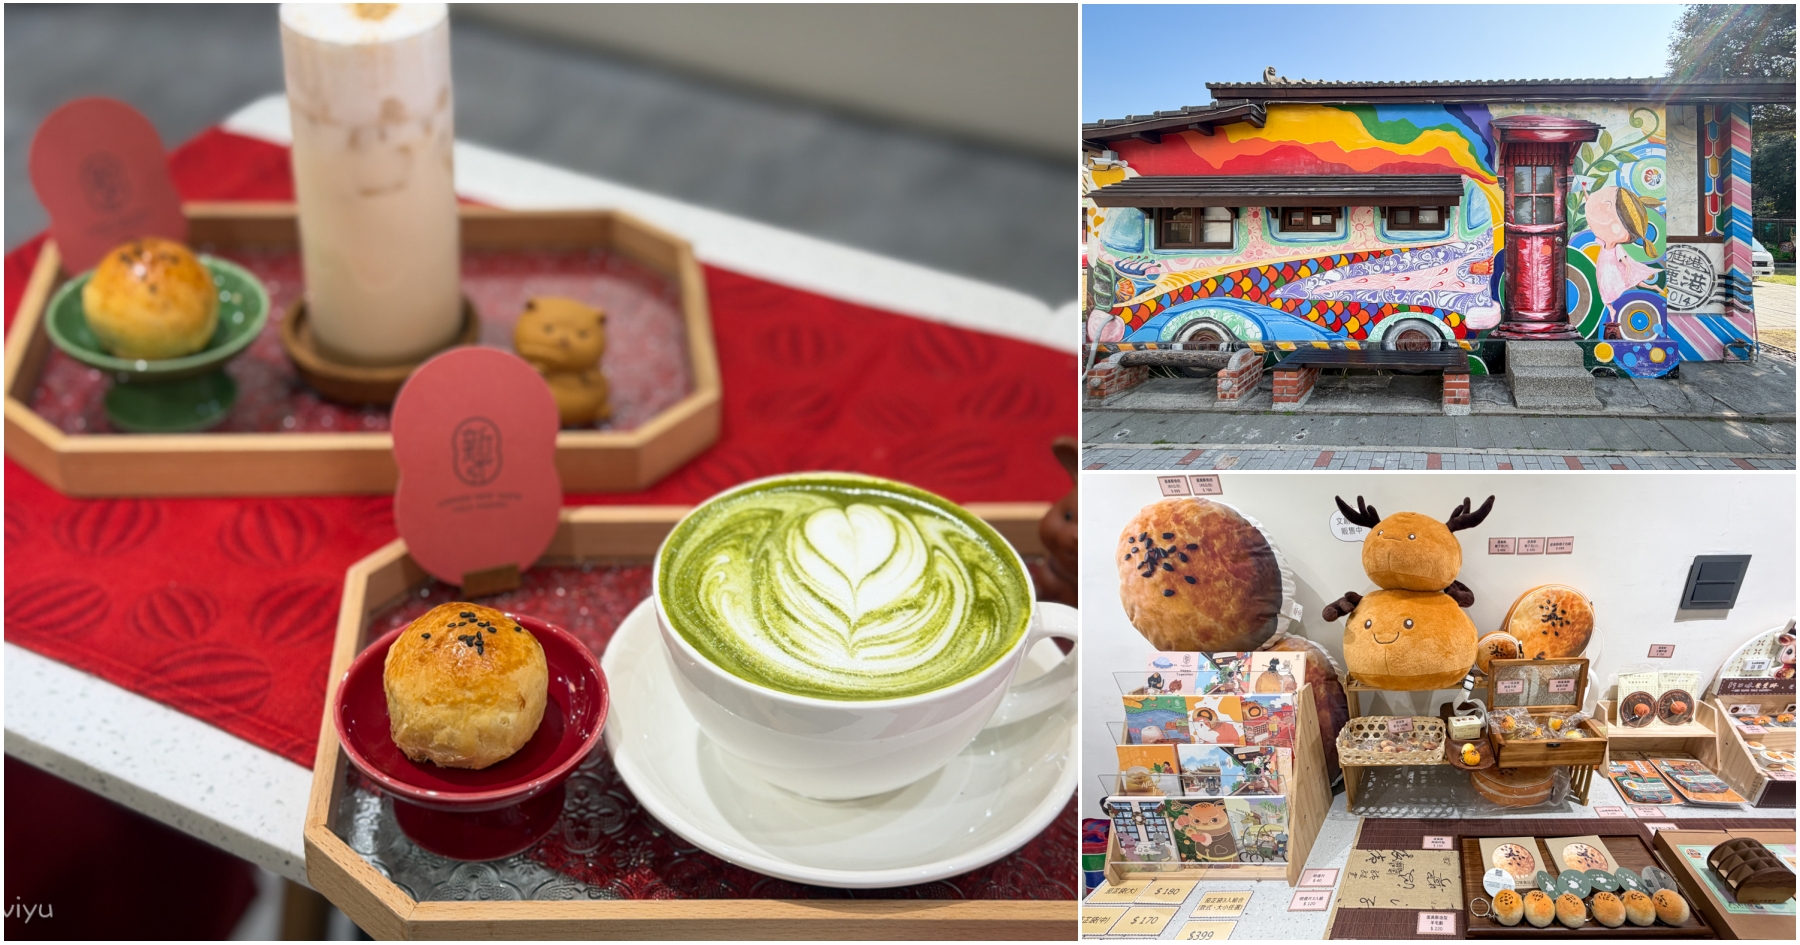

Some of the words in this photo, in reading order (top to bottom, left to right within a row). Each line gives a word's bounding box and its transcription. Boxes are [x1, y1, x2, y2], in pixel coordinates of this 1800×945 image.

[1667, 289, 1691, 306] 014
[1341, 526, 1362, 536] 販售中
